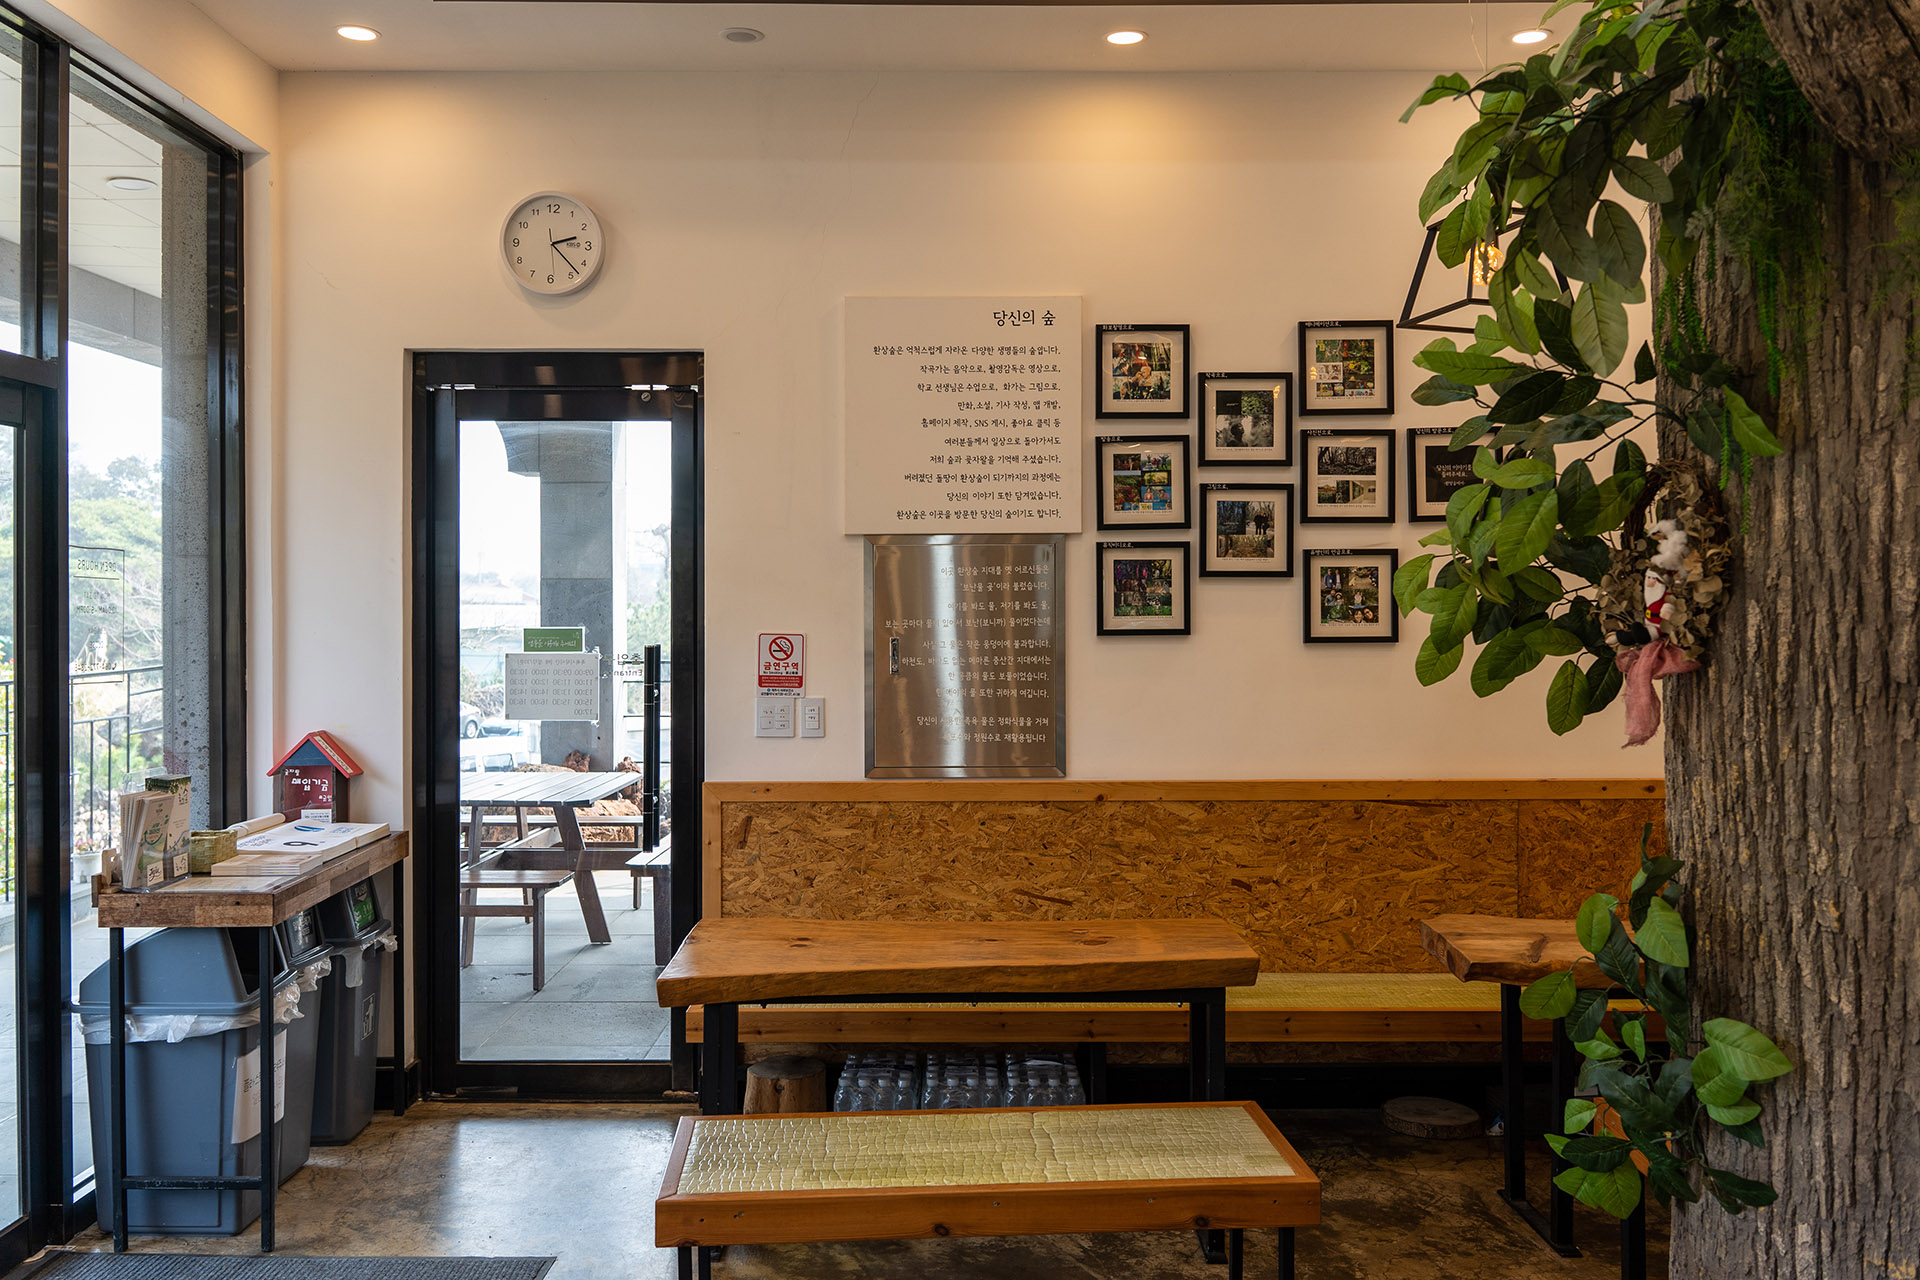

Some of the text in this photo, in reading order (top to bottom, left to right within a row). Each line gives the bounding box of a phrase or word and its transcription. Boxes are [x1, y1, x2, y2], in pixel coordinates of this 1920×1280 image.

[547, 204, 560, 213] 12
[513, 238, 520, 247] 9
[585, 241, 592, 251] 3
[547, 275, 554, 283] 6
[993, 310, 1055, 326] 당신의 숲
[874, 346, 1060, 355] 환상숲은 억척스럽게 자라온 다양한 생명들의 숲입니다.
[920, 364, 1060, 374] 작곡가는 음악으로, 촬영감독은 영상으로,
[918, 384, 932, 392] 학교
[935, 383, 964, 392] 선생님은
[1004, 383, 1025, 391] 화가는
[1029, 382, 1060, 391] 그림으로,
[997, 401, 1010, 409] 기사
[1033, 401, 1040, 410] 앱
[921, 418, 950, 427] 홈페이지
[1011, 419, 1033, 428] 좋아요
[1036, 419, 1050, 428] 클릭
[1054, 419, 1060, 427] 등
[945, 438, 988, 447] 여러분들께서
[991, 437, 1021, 446] 일상으로
[930, 455, 1061, 464] 저희 숲과 곶자왈을 기억해 주셨습니다.
[905, 473, 1061, 483] 버려졌던 돌땅이 환상숲이 되기까지의 과정에는
[947, 491, 1061, 501] 당신의 이야기 또한 담겨있습니다.
[897, 509, 1061, 519] 환상숲은 이곳을 방문한 당신의 숲이기도 합니다.
[941, 566, 954, 575] 이곳
[957, 566, 978, 575] 환상숲
[981, 566, 1001, 575] 지대를
[1015, 566, 1048, 574] 어르신들은
[971, 601, 984, 610] 봐도
[1000, 601, 1020, 610] 저기를
[1024, 601, 1037, 609] 봐도
[885, 619, 898, 628] 보는
[902, 619, 923, 628] 곳마다
[1009, 617, 1050, 626] 물이었다는데
[966, 640, 980, 648] 작은
[983, 639, 1010, 648] 웅덩이에
[1014, 639, 1051, 648] 불과합니다.
[969, 656, 990, 666] 메마른
[993, 656, 1013, 666] 중산간
[1017, 656, 1051, 666] 지대에서는
[763, 662, 798, 671] 금연구역
[982, 672, 995, 681] 물도
[999, 672, 1050, 681] 보물이었습니다.
[969, 689, 976, 698] 물
[979, 689, 993, 698] 또한
[996, 689, 1017, 698] 귀하게
[917, 716, 937, 726] 당신이
[981, 716, 994, 726] 물은
[1036, 716, 1048, 726] 거쳐
[974, 732, 1001, 743] 정원수로
[291, 778, 328, 792] 매입기금
